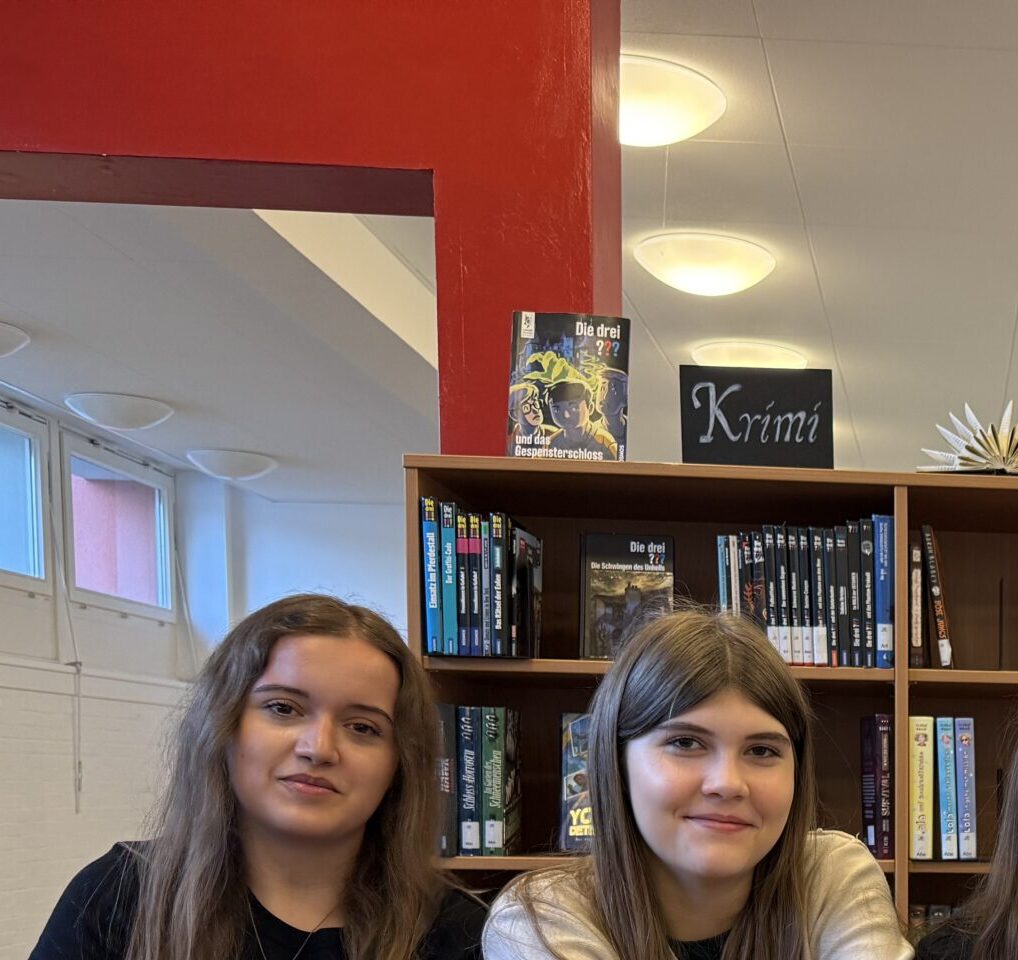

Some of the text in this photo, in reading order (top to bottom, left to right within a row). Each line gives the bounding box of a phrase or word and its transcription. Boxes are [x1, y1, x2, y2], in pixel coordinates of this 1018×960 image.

[576, 322, 620, 338] Die drei
[692, 382, 821, 443] Krimi
[516, 434, 551, 445] und das
[514, 446, 604, 461] Gespensterschloss
[630, 542, 666, 554] Die drei
